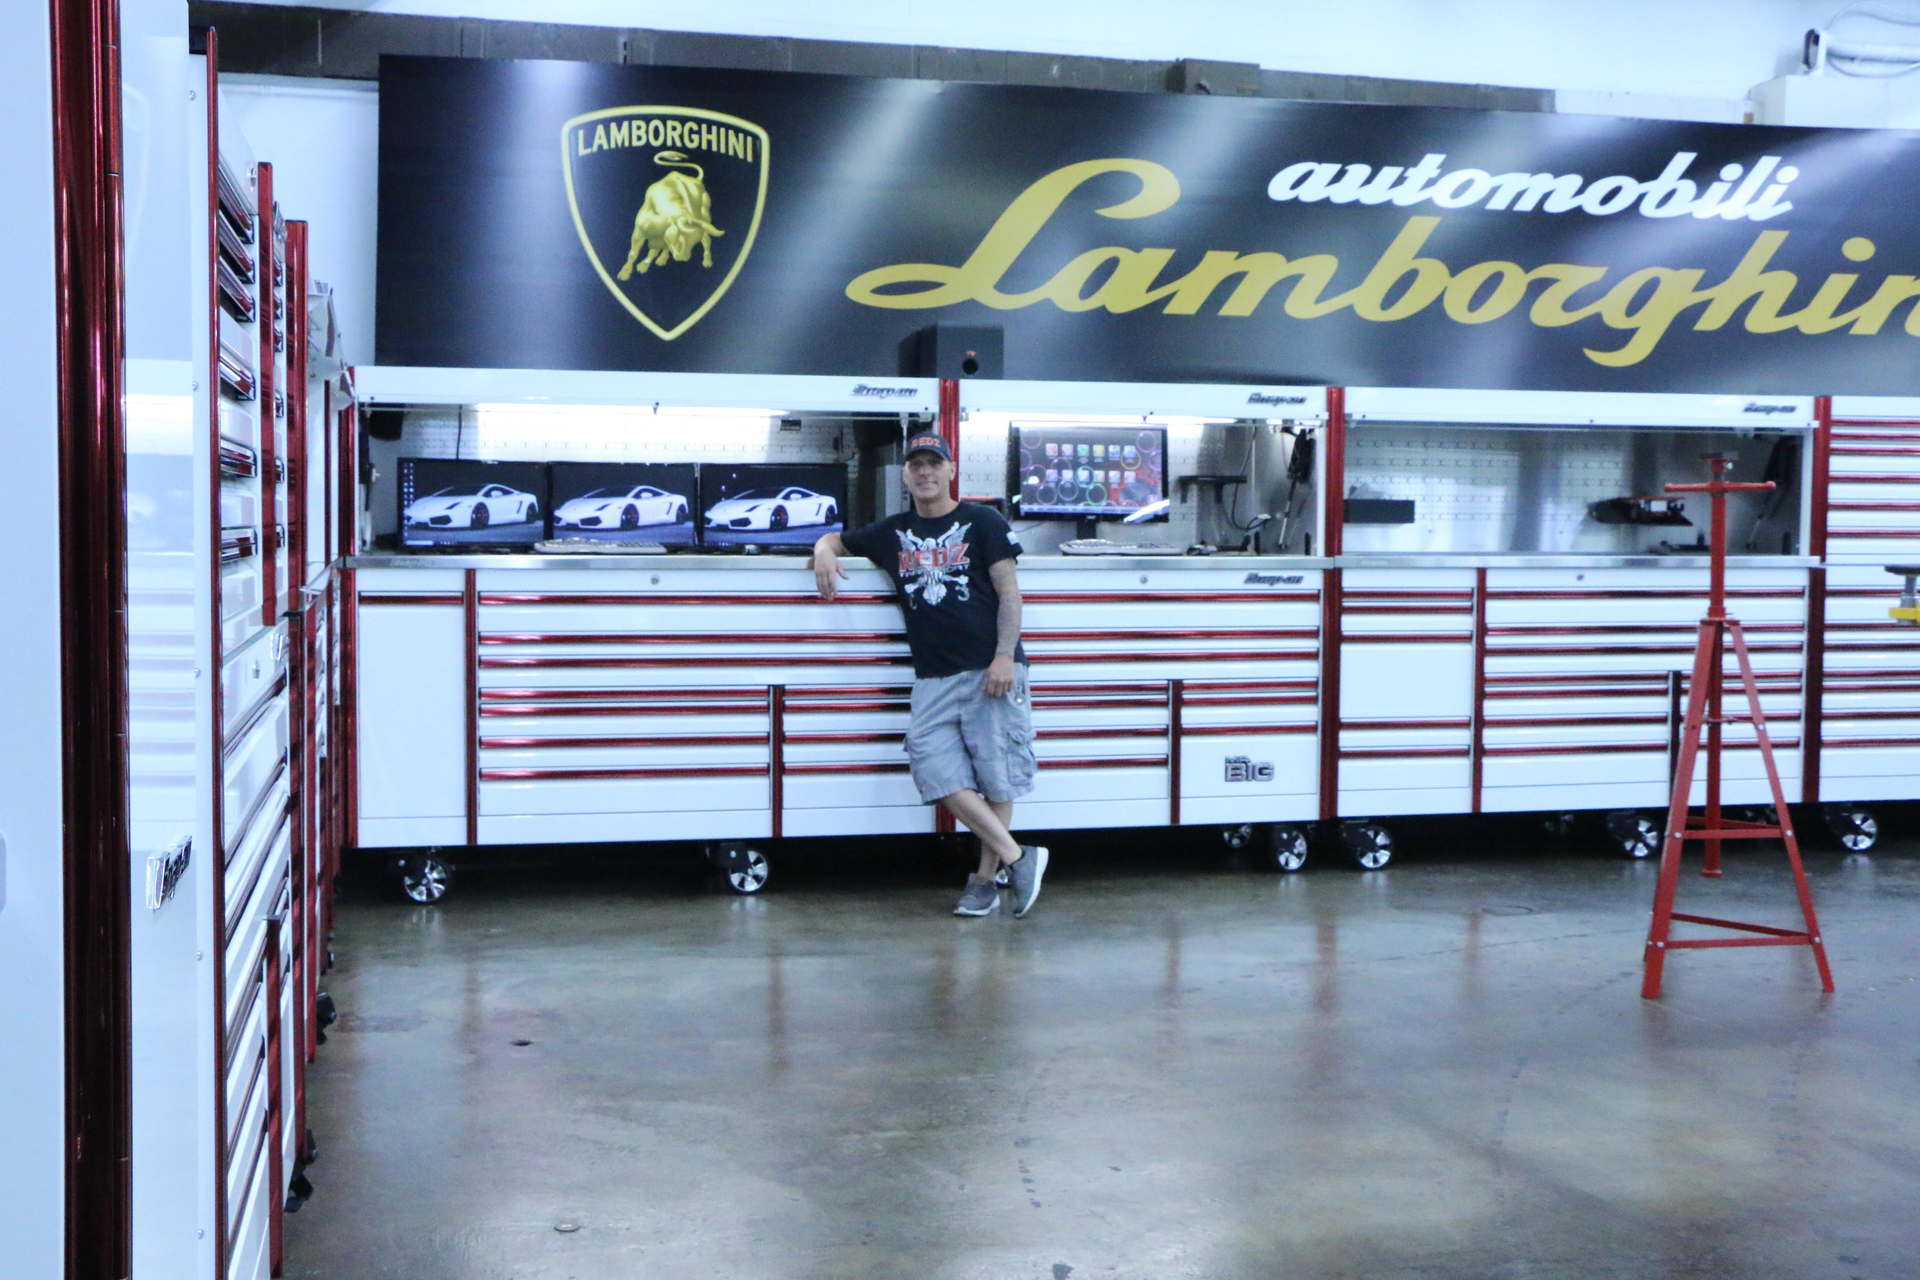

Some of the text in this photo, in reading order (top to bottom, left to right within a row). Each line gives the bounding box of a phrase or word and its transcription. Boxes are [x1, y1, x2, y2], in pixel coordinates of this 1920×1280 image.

[578, 119, 753, 162] LAMBORGHINI
[1267, 151, 1799, 221] automobili
[898, 543, 970, 572] REDZ
[1225, 762, 1275, 782] BIG
